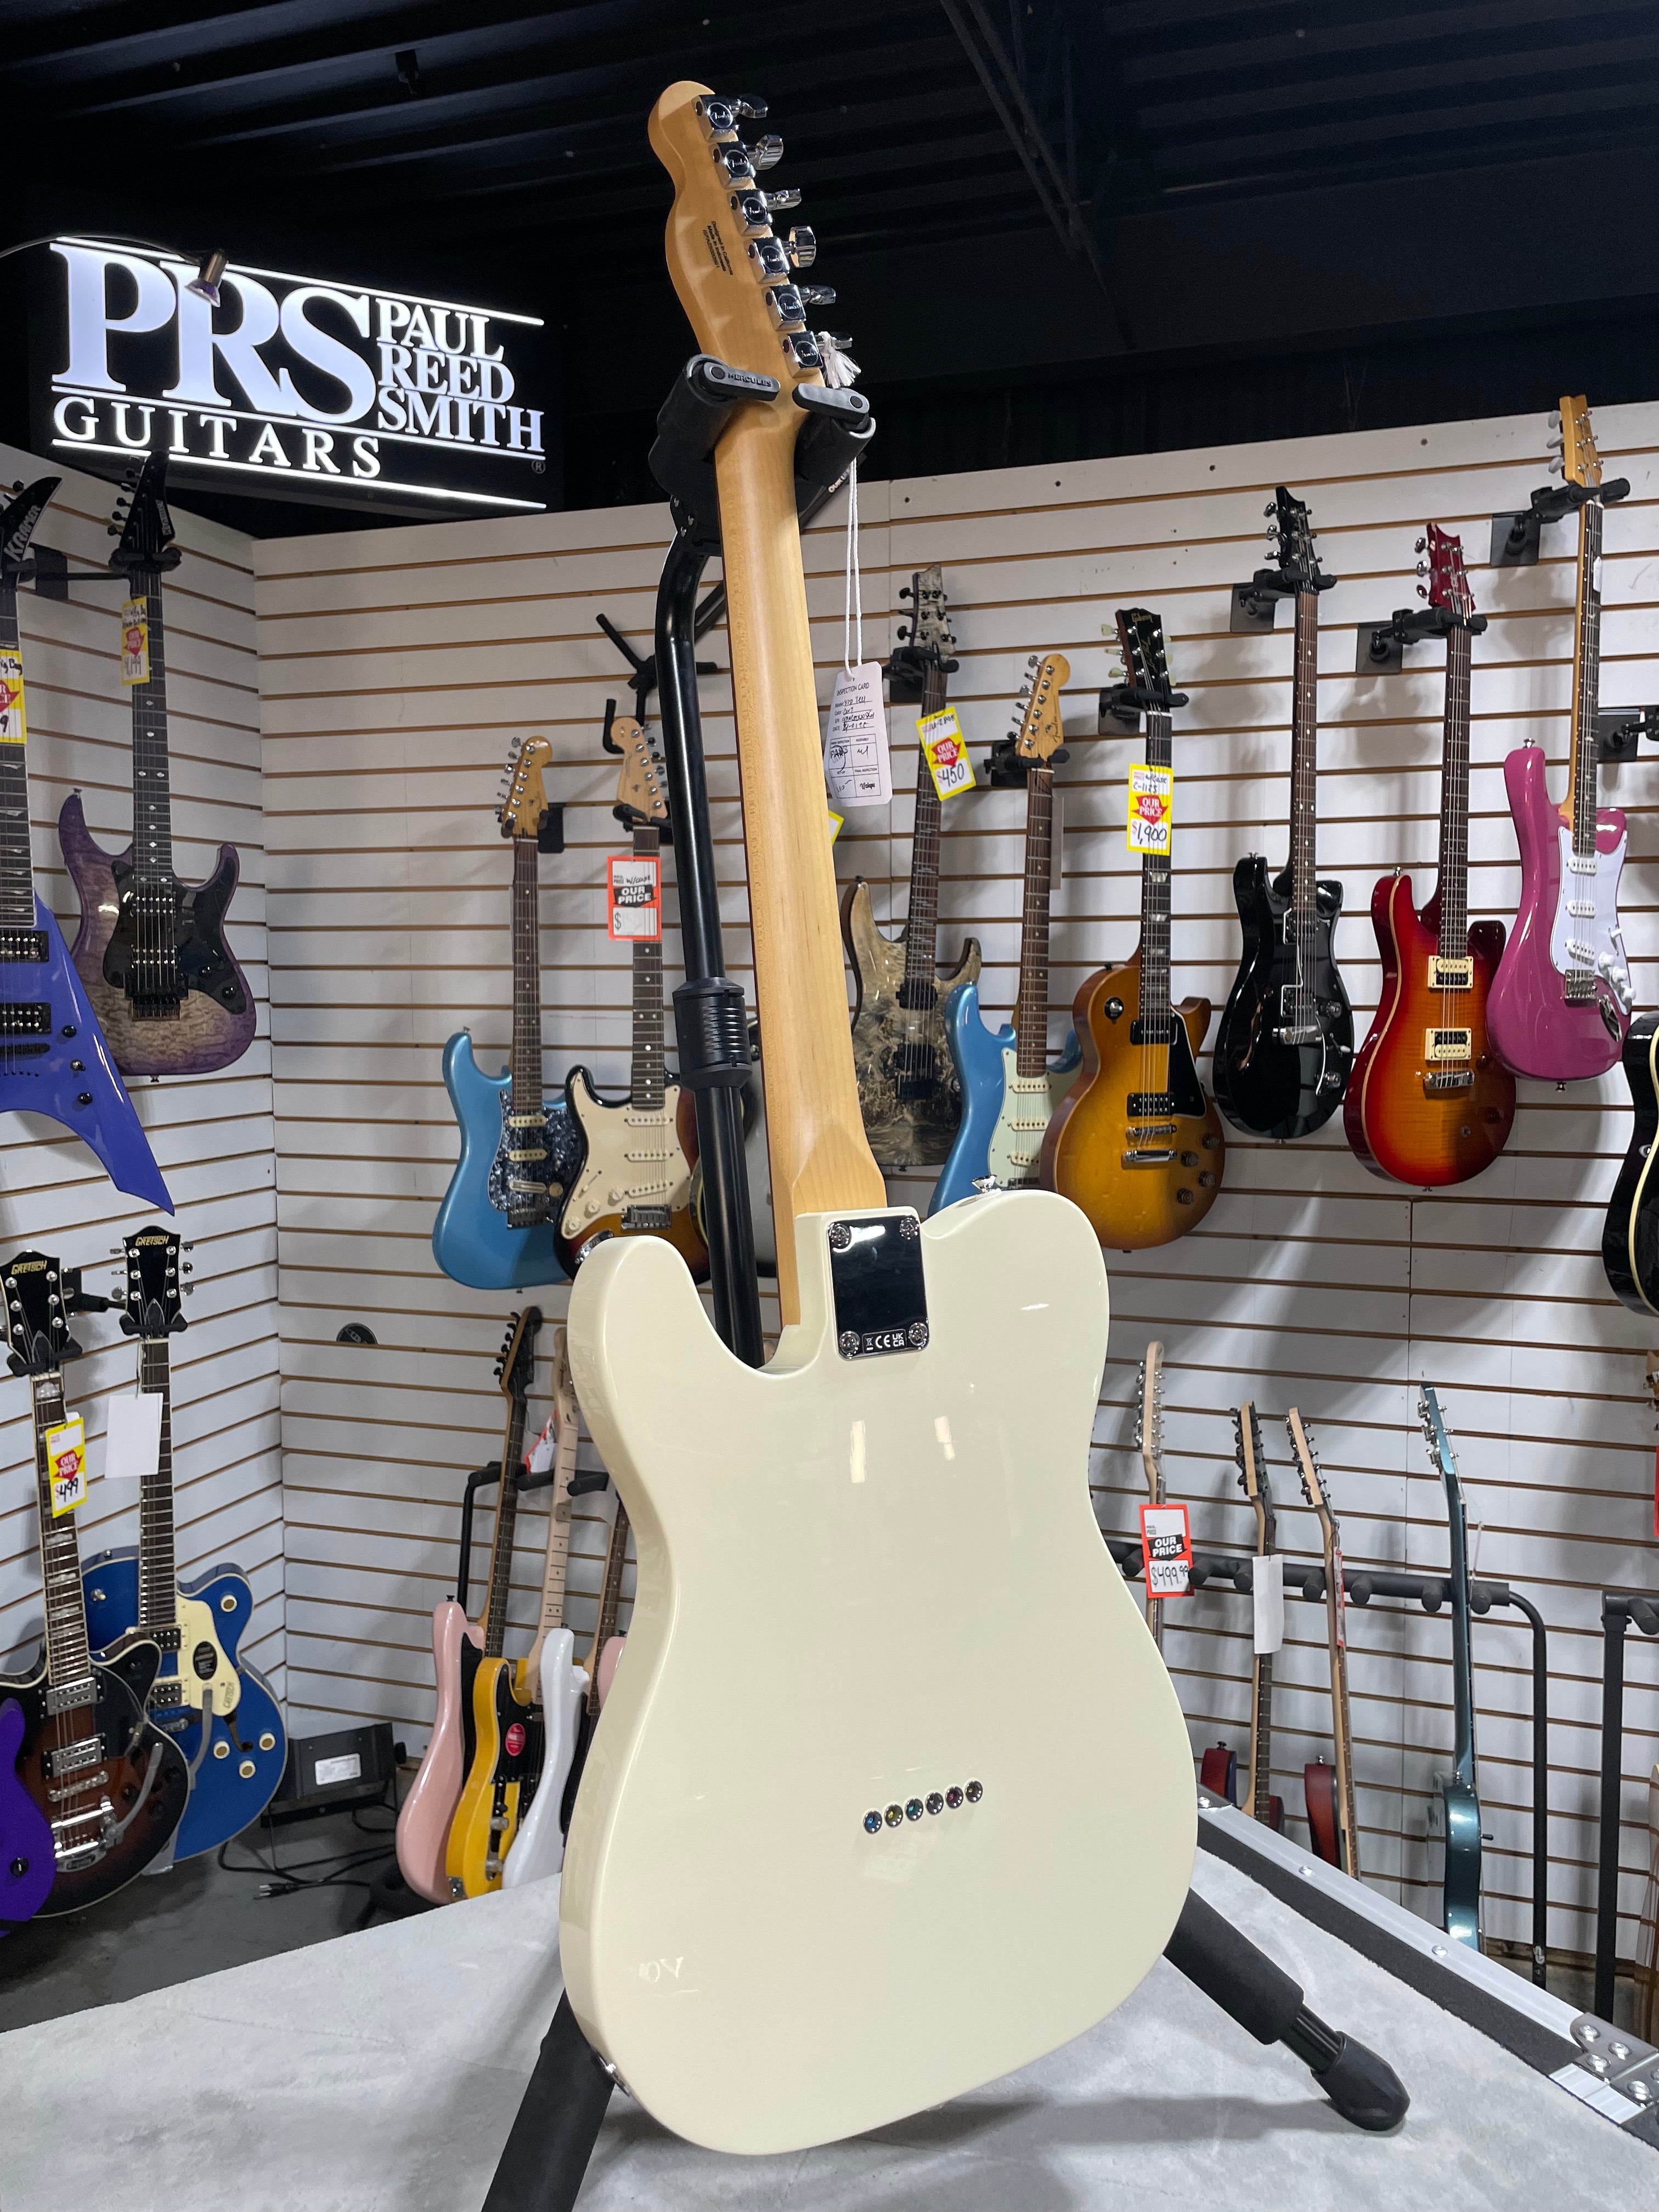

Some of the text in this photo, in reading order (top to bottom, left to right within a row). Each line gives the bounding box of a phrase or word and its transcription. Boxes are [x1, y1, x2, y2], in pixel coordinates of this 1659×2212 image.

[49, 242, 376, 424] PRS
[376, 297, 504, 360] PAUL
[377, 340, 515, 404] REED
[727, 372, 772, 387] HERCULES
[377, 387, 545, 452] SMITH
[53, 397, 380, 478] GUITARS
[4, 505, 41, 562] KRAMER
[837, 686, 857, 696] INSPECTION
[937, 741, 955, 754] OUR
[938, 748, 958, 763] PRICE
[1142, 797, 1159, 808] OUR
[1139, 806, 1163, 817] PRICE
[1132, 821, 1167, 845] $1,900
[622, 886, 645, 895] OUR
[618, 893, 651, 904] PRICE
[135, 1235, 169, 1246] GRETSCH
[11, 1260, 47, 1275] GRETSCH
[875, 1334, 891, 1348] CE
[1154, 1536, 1177, 1548] OUR
[1153, 1544, 1183, 1558] PRICE
